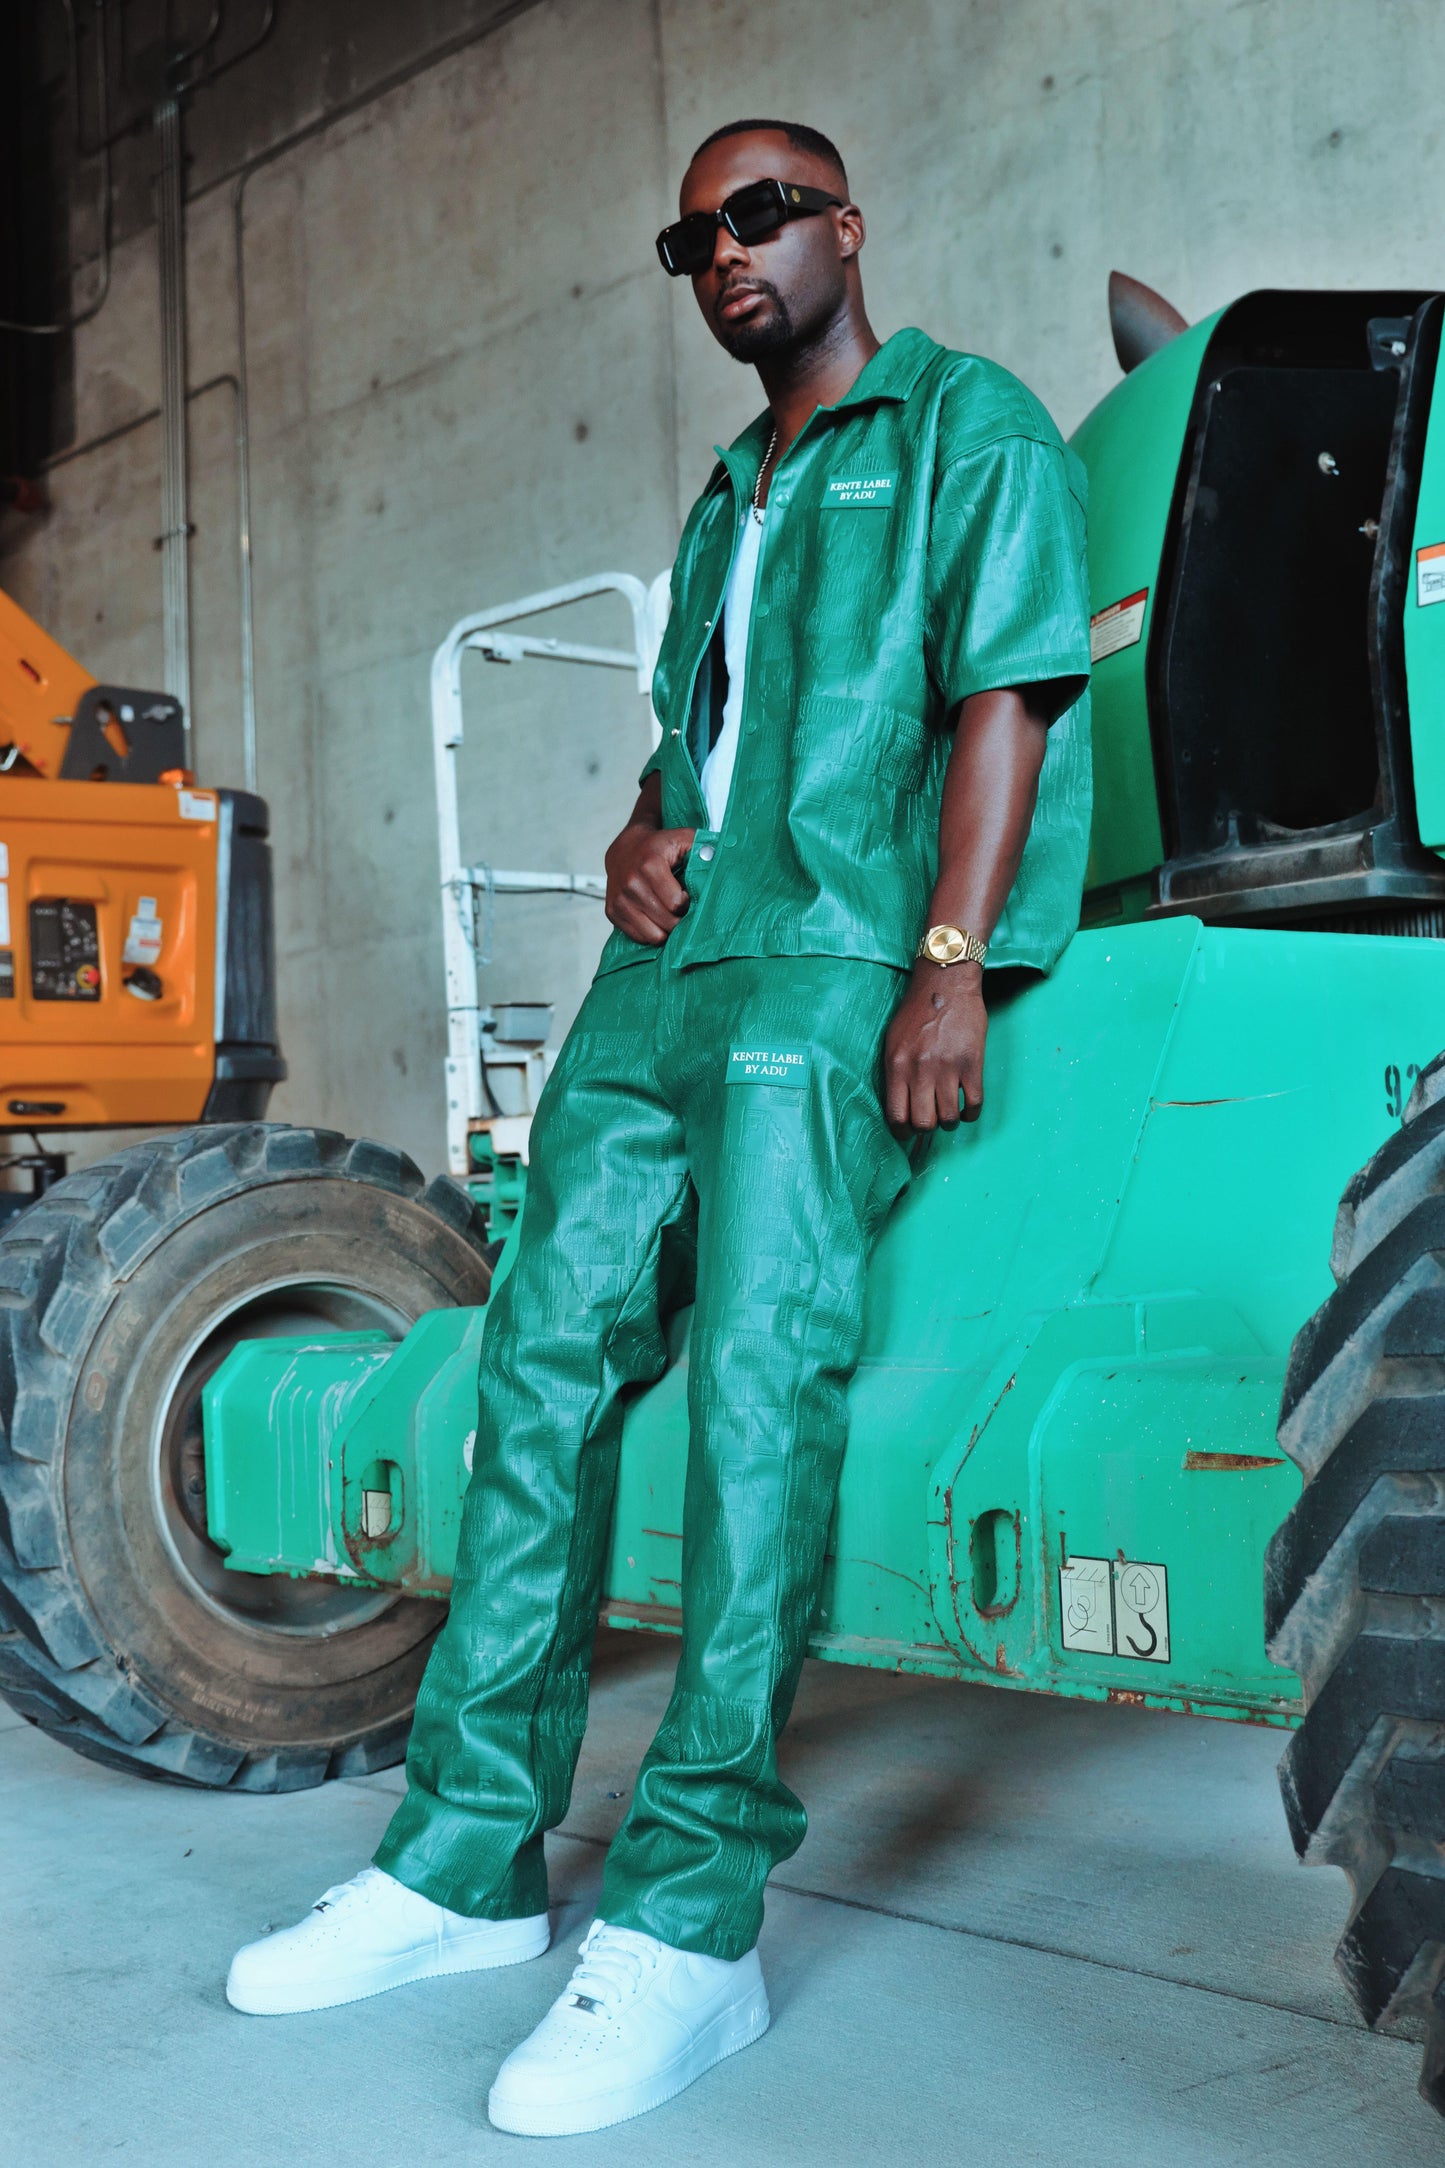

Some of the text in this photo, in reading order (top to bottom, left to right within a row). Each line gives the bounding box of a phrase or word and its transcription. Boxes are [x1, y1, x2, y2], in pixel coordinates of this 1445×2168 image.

[830, 479, 892, 491] KENTE LABEL
[839, 490, 877, 500] BY ADU
[732, 1052, 805, 1065] KENTE LABEL
[744, 1064, 788, 1077] BY ADU
